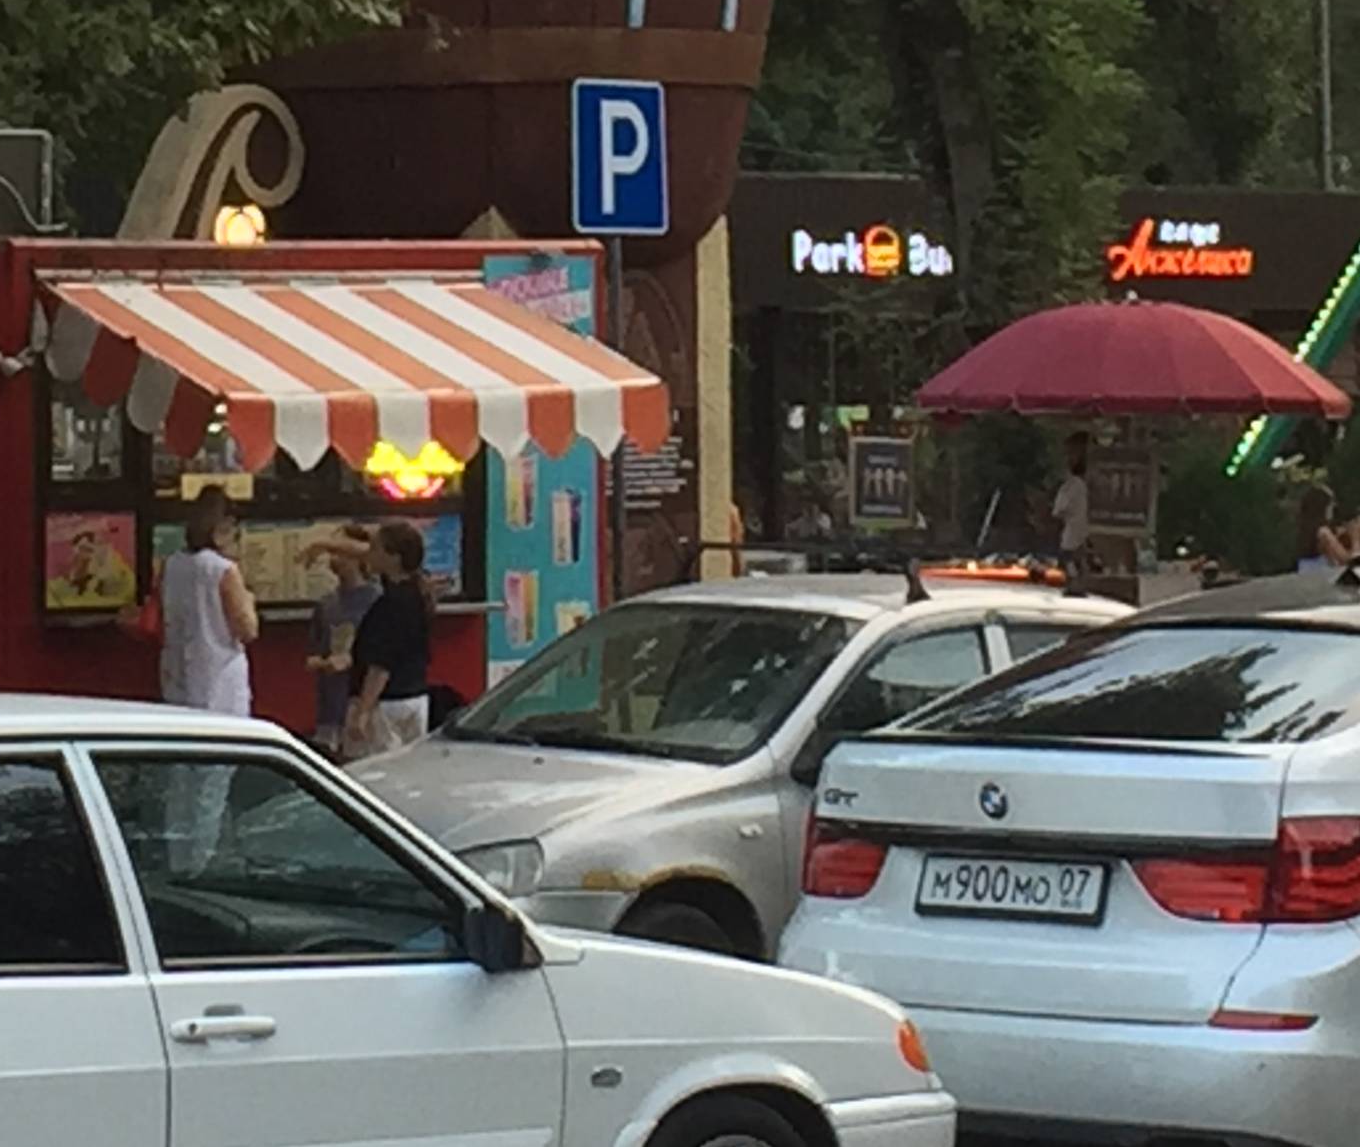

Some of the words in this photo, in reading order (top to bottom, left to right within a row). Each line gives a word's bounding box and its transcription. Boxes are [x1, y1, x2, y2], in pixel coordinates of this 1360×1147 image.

[600, 99, 648, 215] P
[792, 228, 866, 273] Park
[908, 231, 953, 277] Bun
